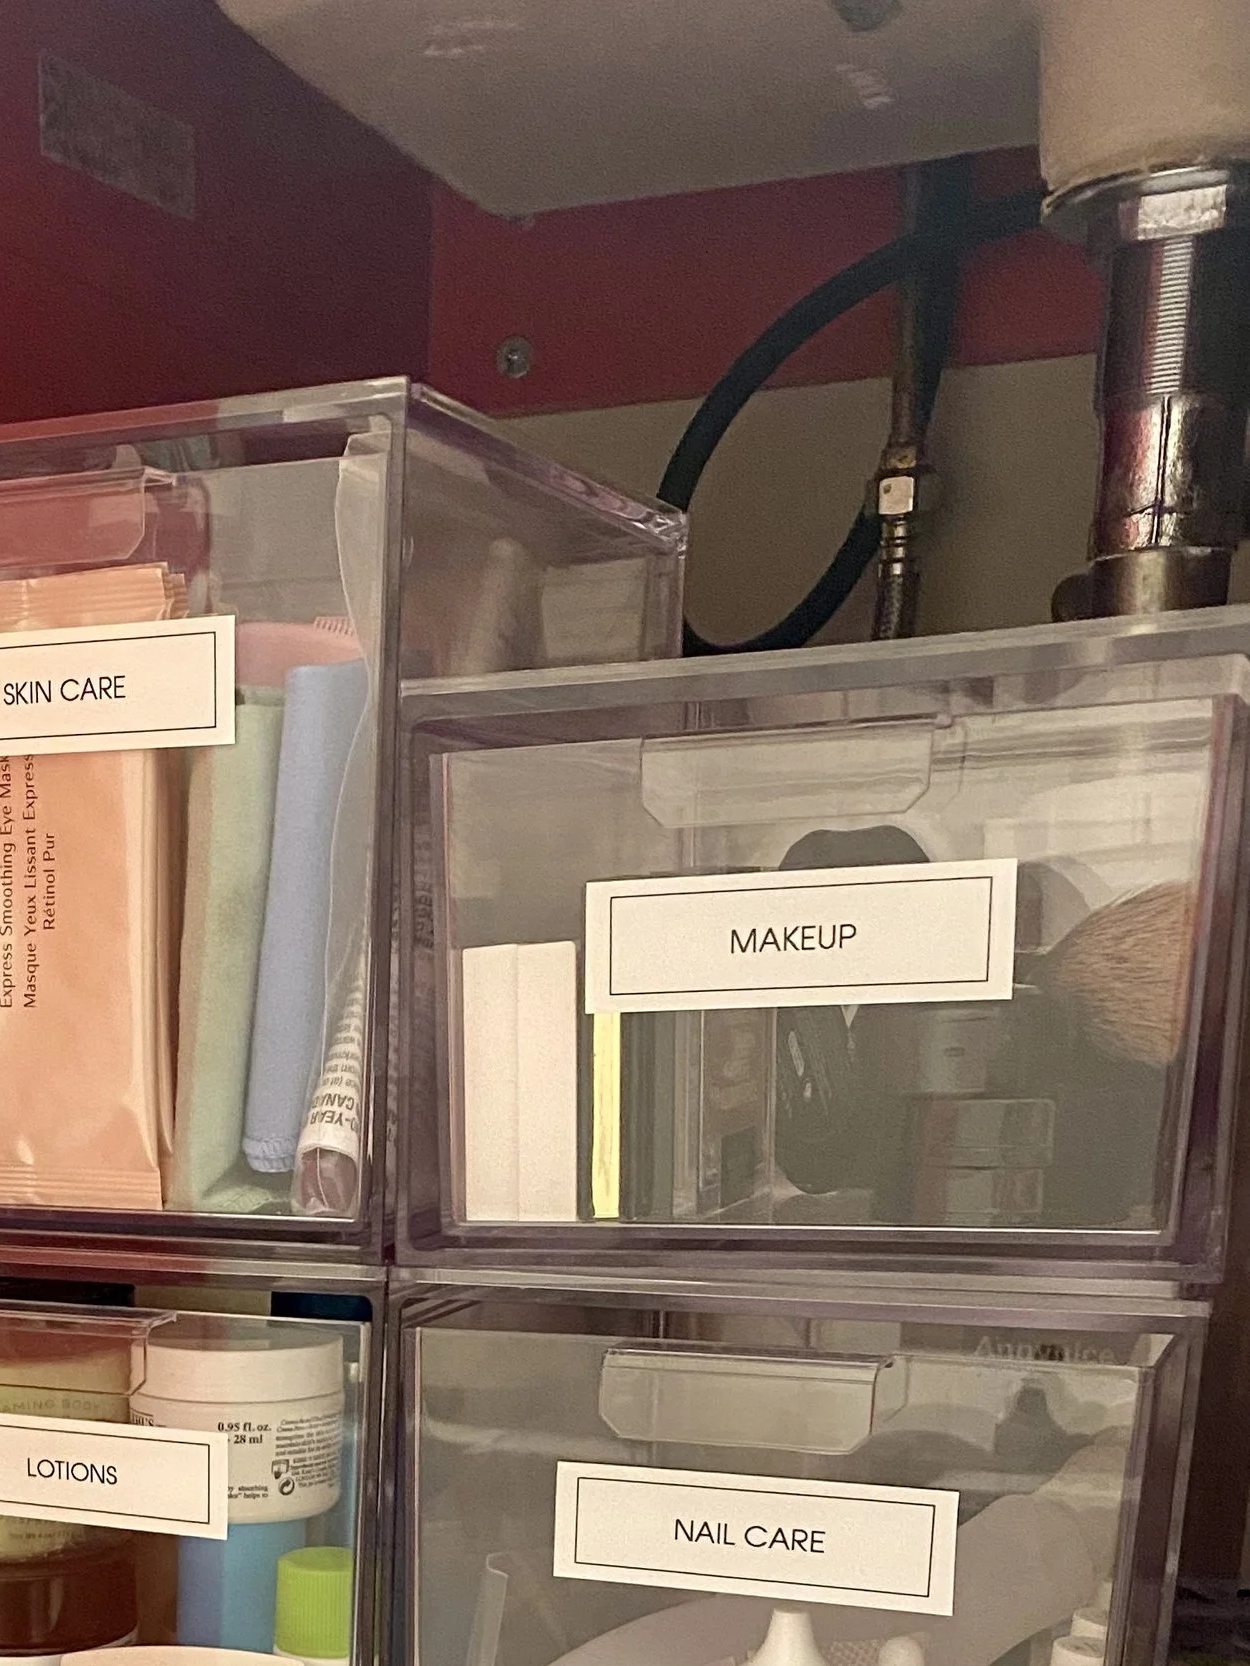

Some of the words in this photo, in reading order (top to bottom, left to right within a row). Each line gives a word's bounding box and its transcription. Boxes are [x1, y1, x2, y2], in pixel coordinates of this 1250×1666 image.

[2, 680, 52, 706] SKIN
[60, 675, 126, 702] CARE
[22, 754, 39, 823] Express
[0, 805, 15, 836] Eye
[23, 827, 37, 890] Lissant
[42, 832, 56, 862] Pur
[0, 842, 17, 936] Smoothing
[42, 866, 56, 930] Rétinol
[23, 894, 37, 937] Yeux
[729, 923, 857, 954] MAKEUP
[0, 943, 16, 1008] Express
[23, 942, 40, 1008] Masque
[217, 1421, 240, 1433] 0.95
[234, 1434, 246, 1444] 28
[249, 1433, 263, 1444] ml
[27, 1457, 118, 1485] LOTIONS
[673, 1517, 736, 1548] NAIL
[743, 1525, 826, 1555] CARE
